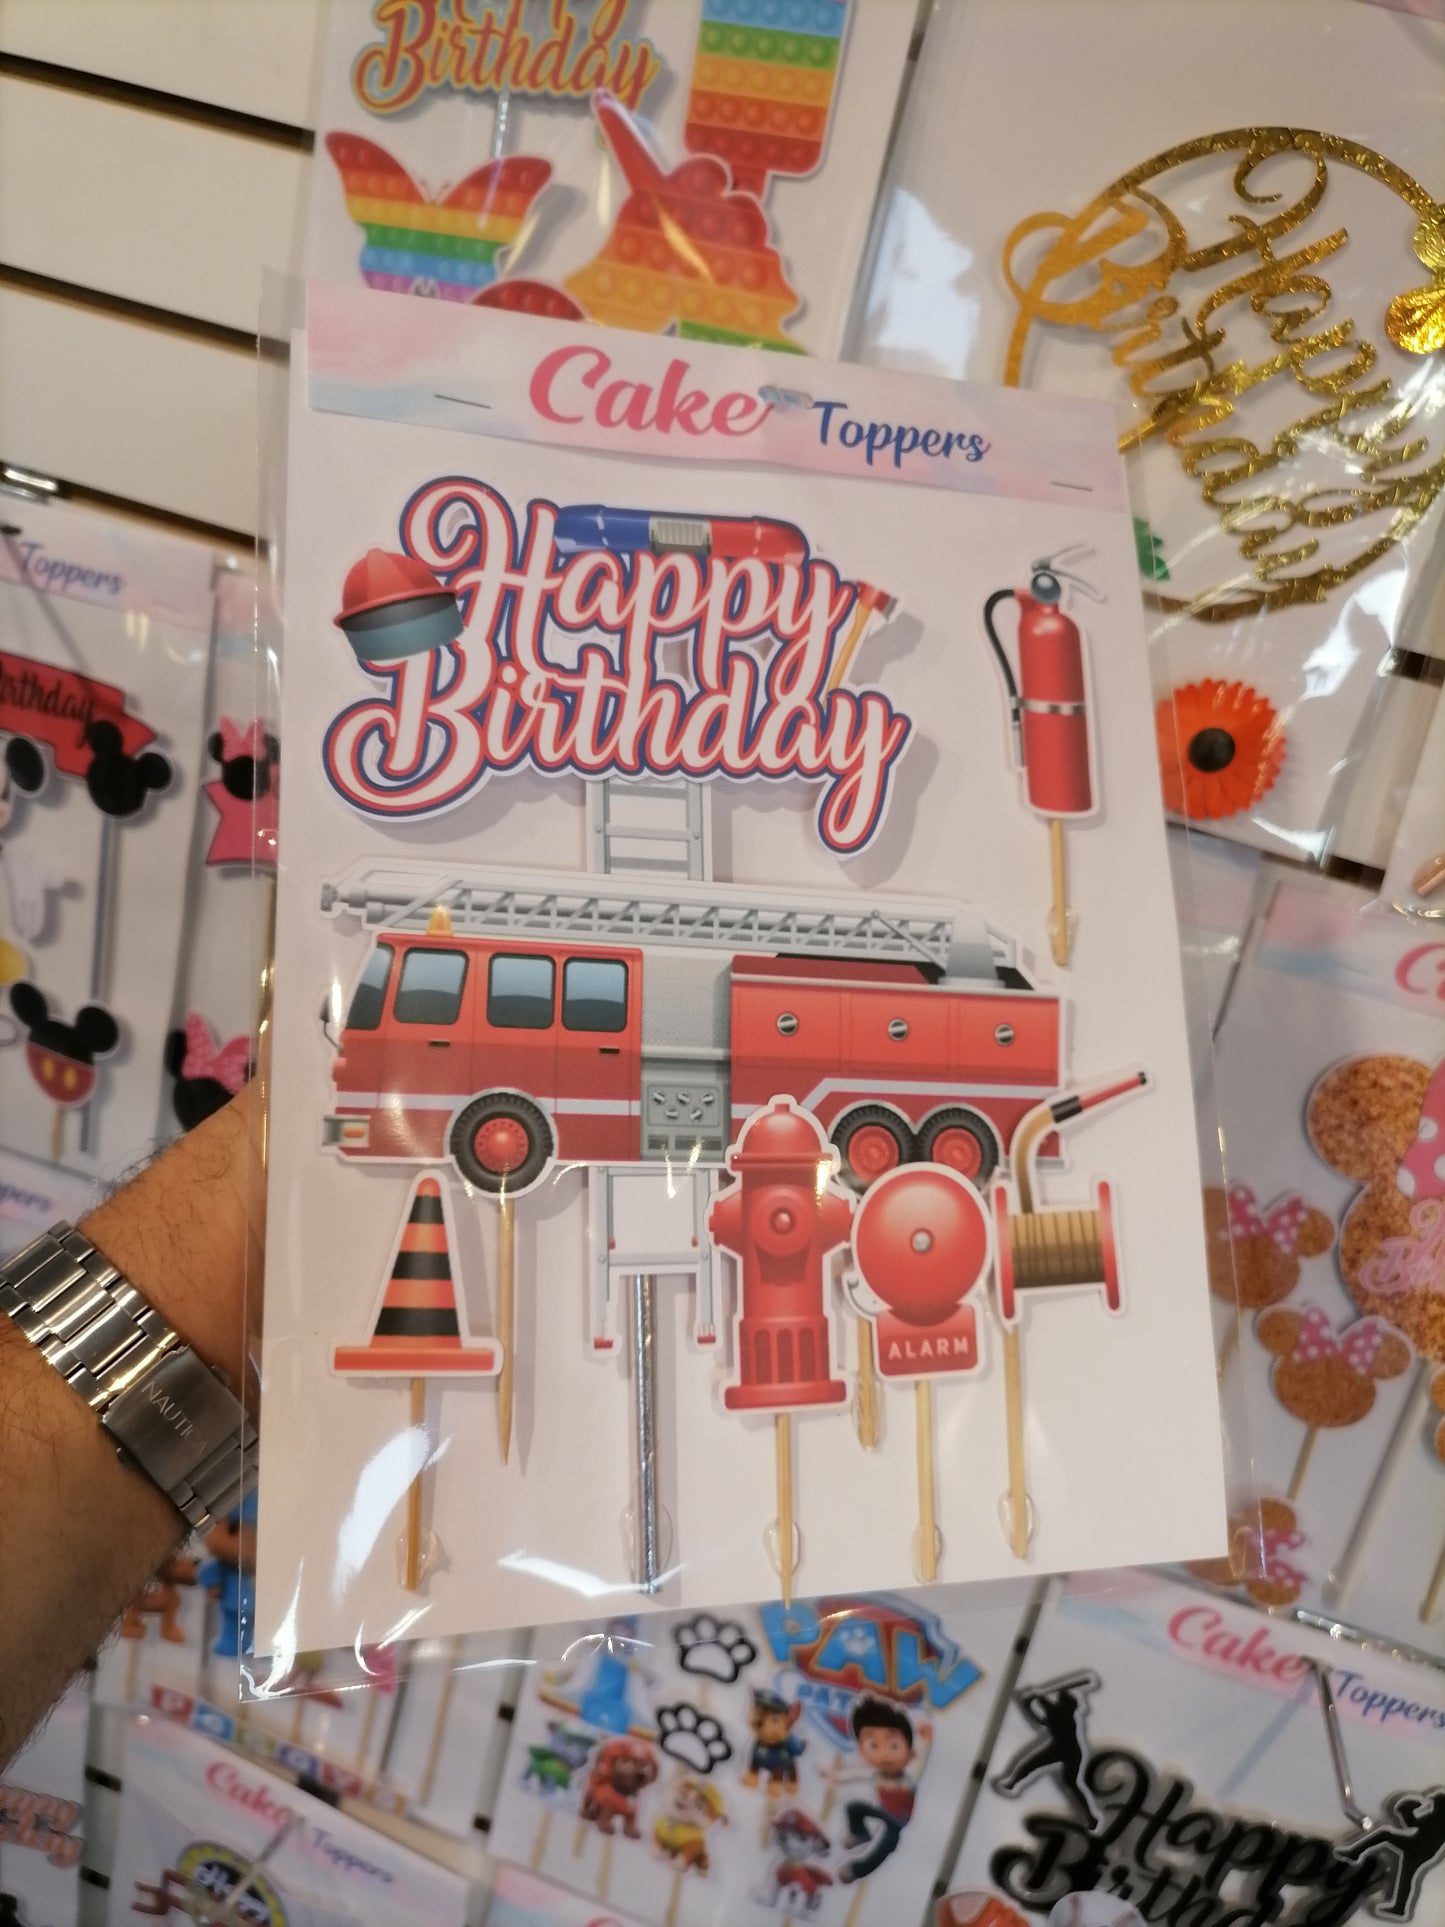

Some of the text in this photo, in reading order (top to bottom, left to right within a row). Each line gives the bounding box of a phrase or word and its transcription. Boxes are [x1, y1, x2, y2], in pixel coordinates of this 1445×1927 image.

[354, 0, 660, 115] Birthday
[529, 345, 992, 468] Cake Toppers
[21, 541, 122, 595] Toppers
[400, 476, 858, 700] Happy
[323, 634, 911, 853] Birthday
[888, 1336, 969, 1360] ALARM
[760, 1603, 983, 1709] PAW
[1167, 1605, 1309, 1680] Cake
[205, 1761, 395, 1883] Cake Toppers
[1085, 1750, 1390, 1927] Happy
